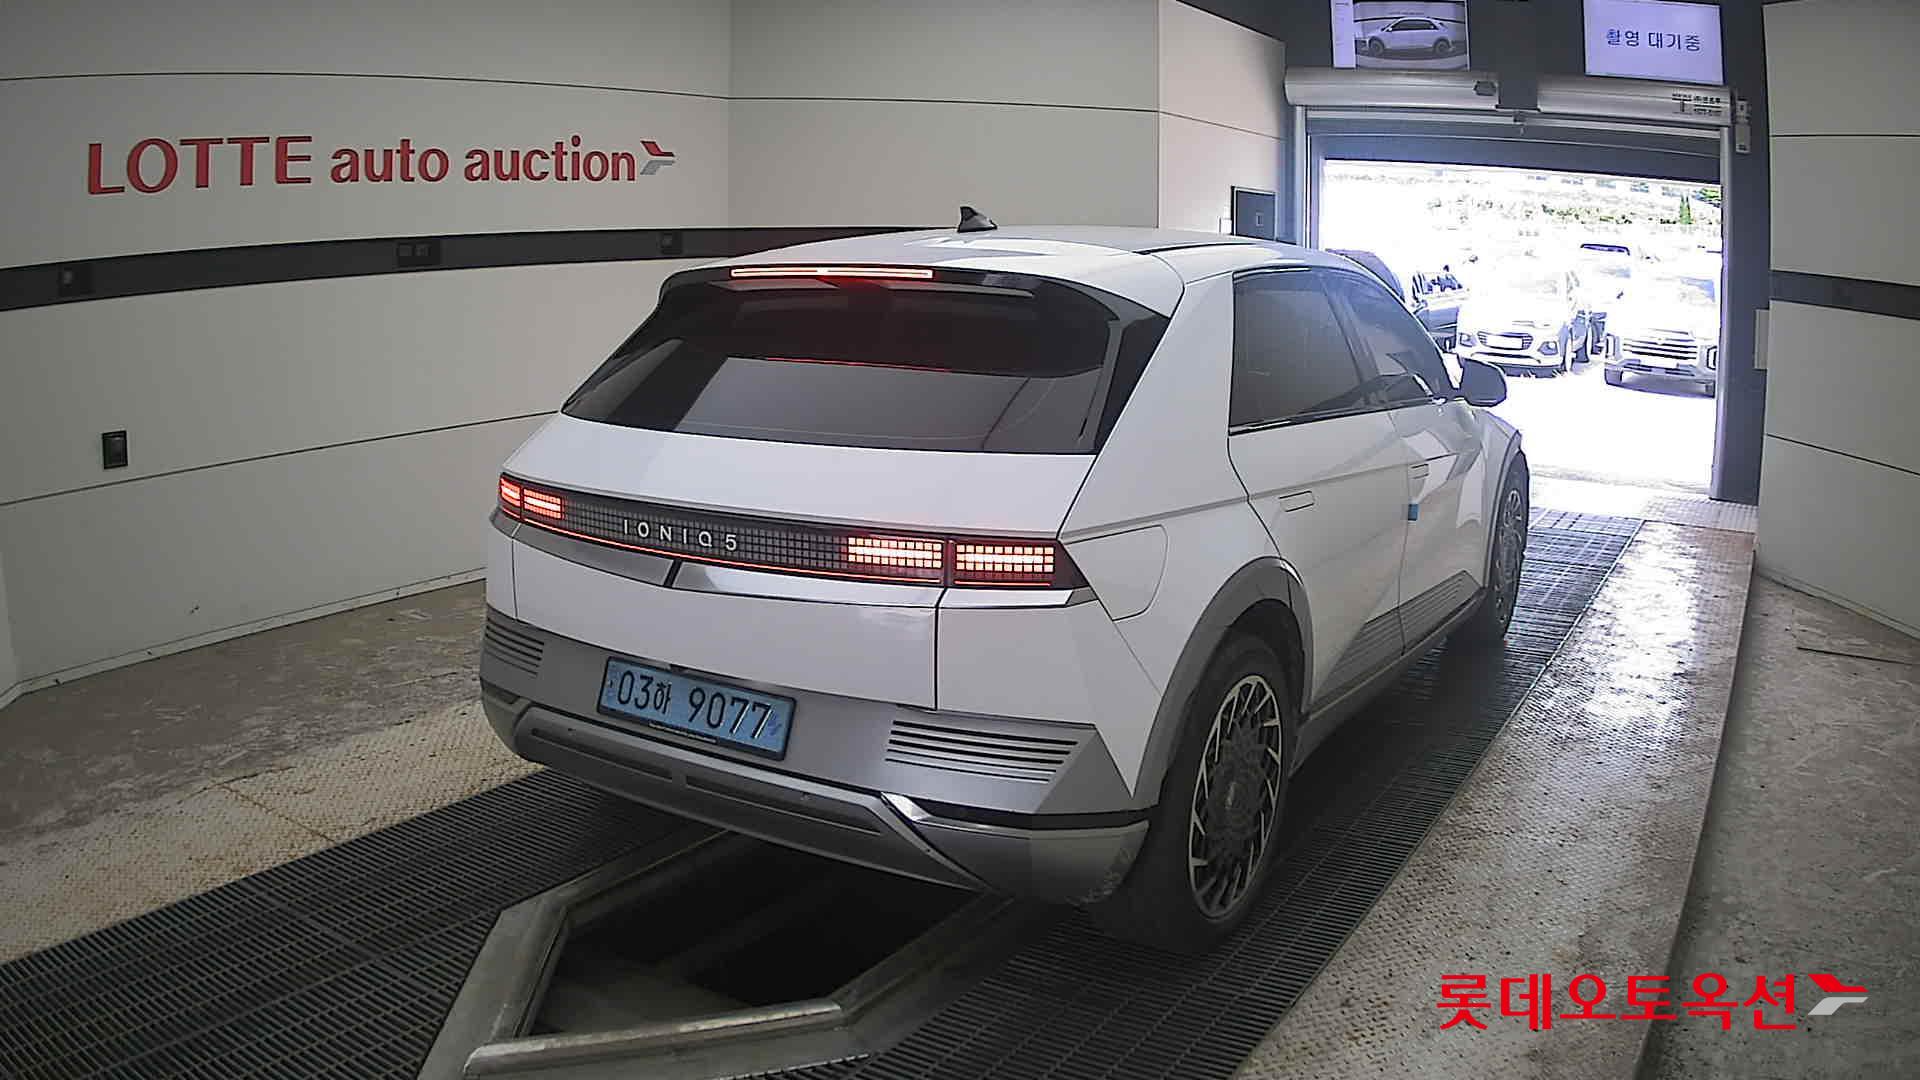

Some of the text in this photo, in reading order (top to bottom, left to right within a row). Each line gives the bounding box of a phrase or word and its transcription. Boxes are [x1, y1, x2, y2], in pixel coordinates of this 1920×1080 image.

[1647, 31, 1701, 52] 대기중
[87, 134, 636, 195] LOTTE auto auction
[622, 518, 738, 551] IONIQ 5
[616, 669, 774, 740] 03하 9077
